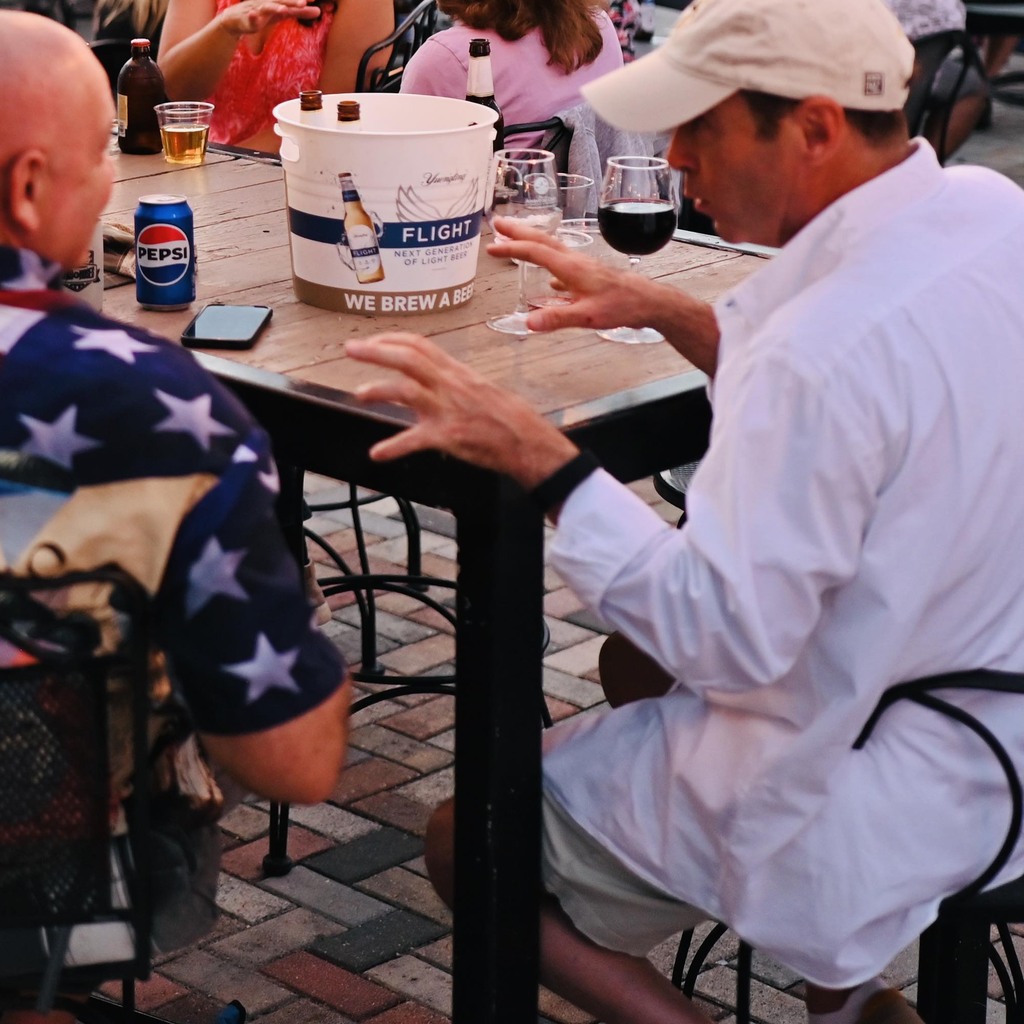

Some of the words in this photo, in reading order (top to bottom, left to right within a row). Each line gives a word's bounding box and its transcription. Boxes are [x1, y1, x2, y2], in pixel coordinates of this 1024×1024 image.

[402, 220, 472, 242] FLIGHT
[138, 247, 187, 261] PEPSI
[394, 249, 422, 257] NEXT
[425, 242, 473, 256] GENERATION
[404, 258, 417, 266] OF
[422, 255, 448, 265] LIGHT
[450, 250, 468, 261] BEER
[344, 293, 376, 311] WE
[381, 294, 437, 312] BREW
[438, 291, 451, 308] A
